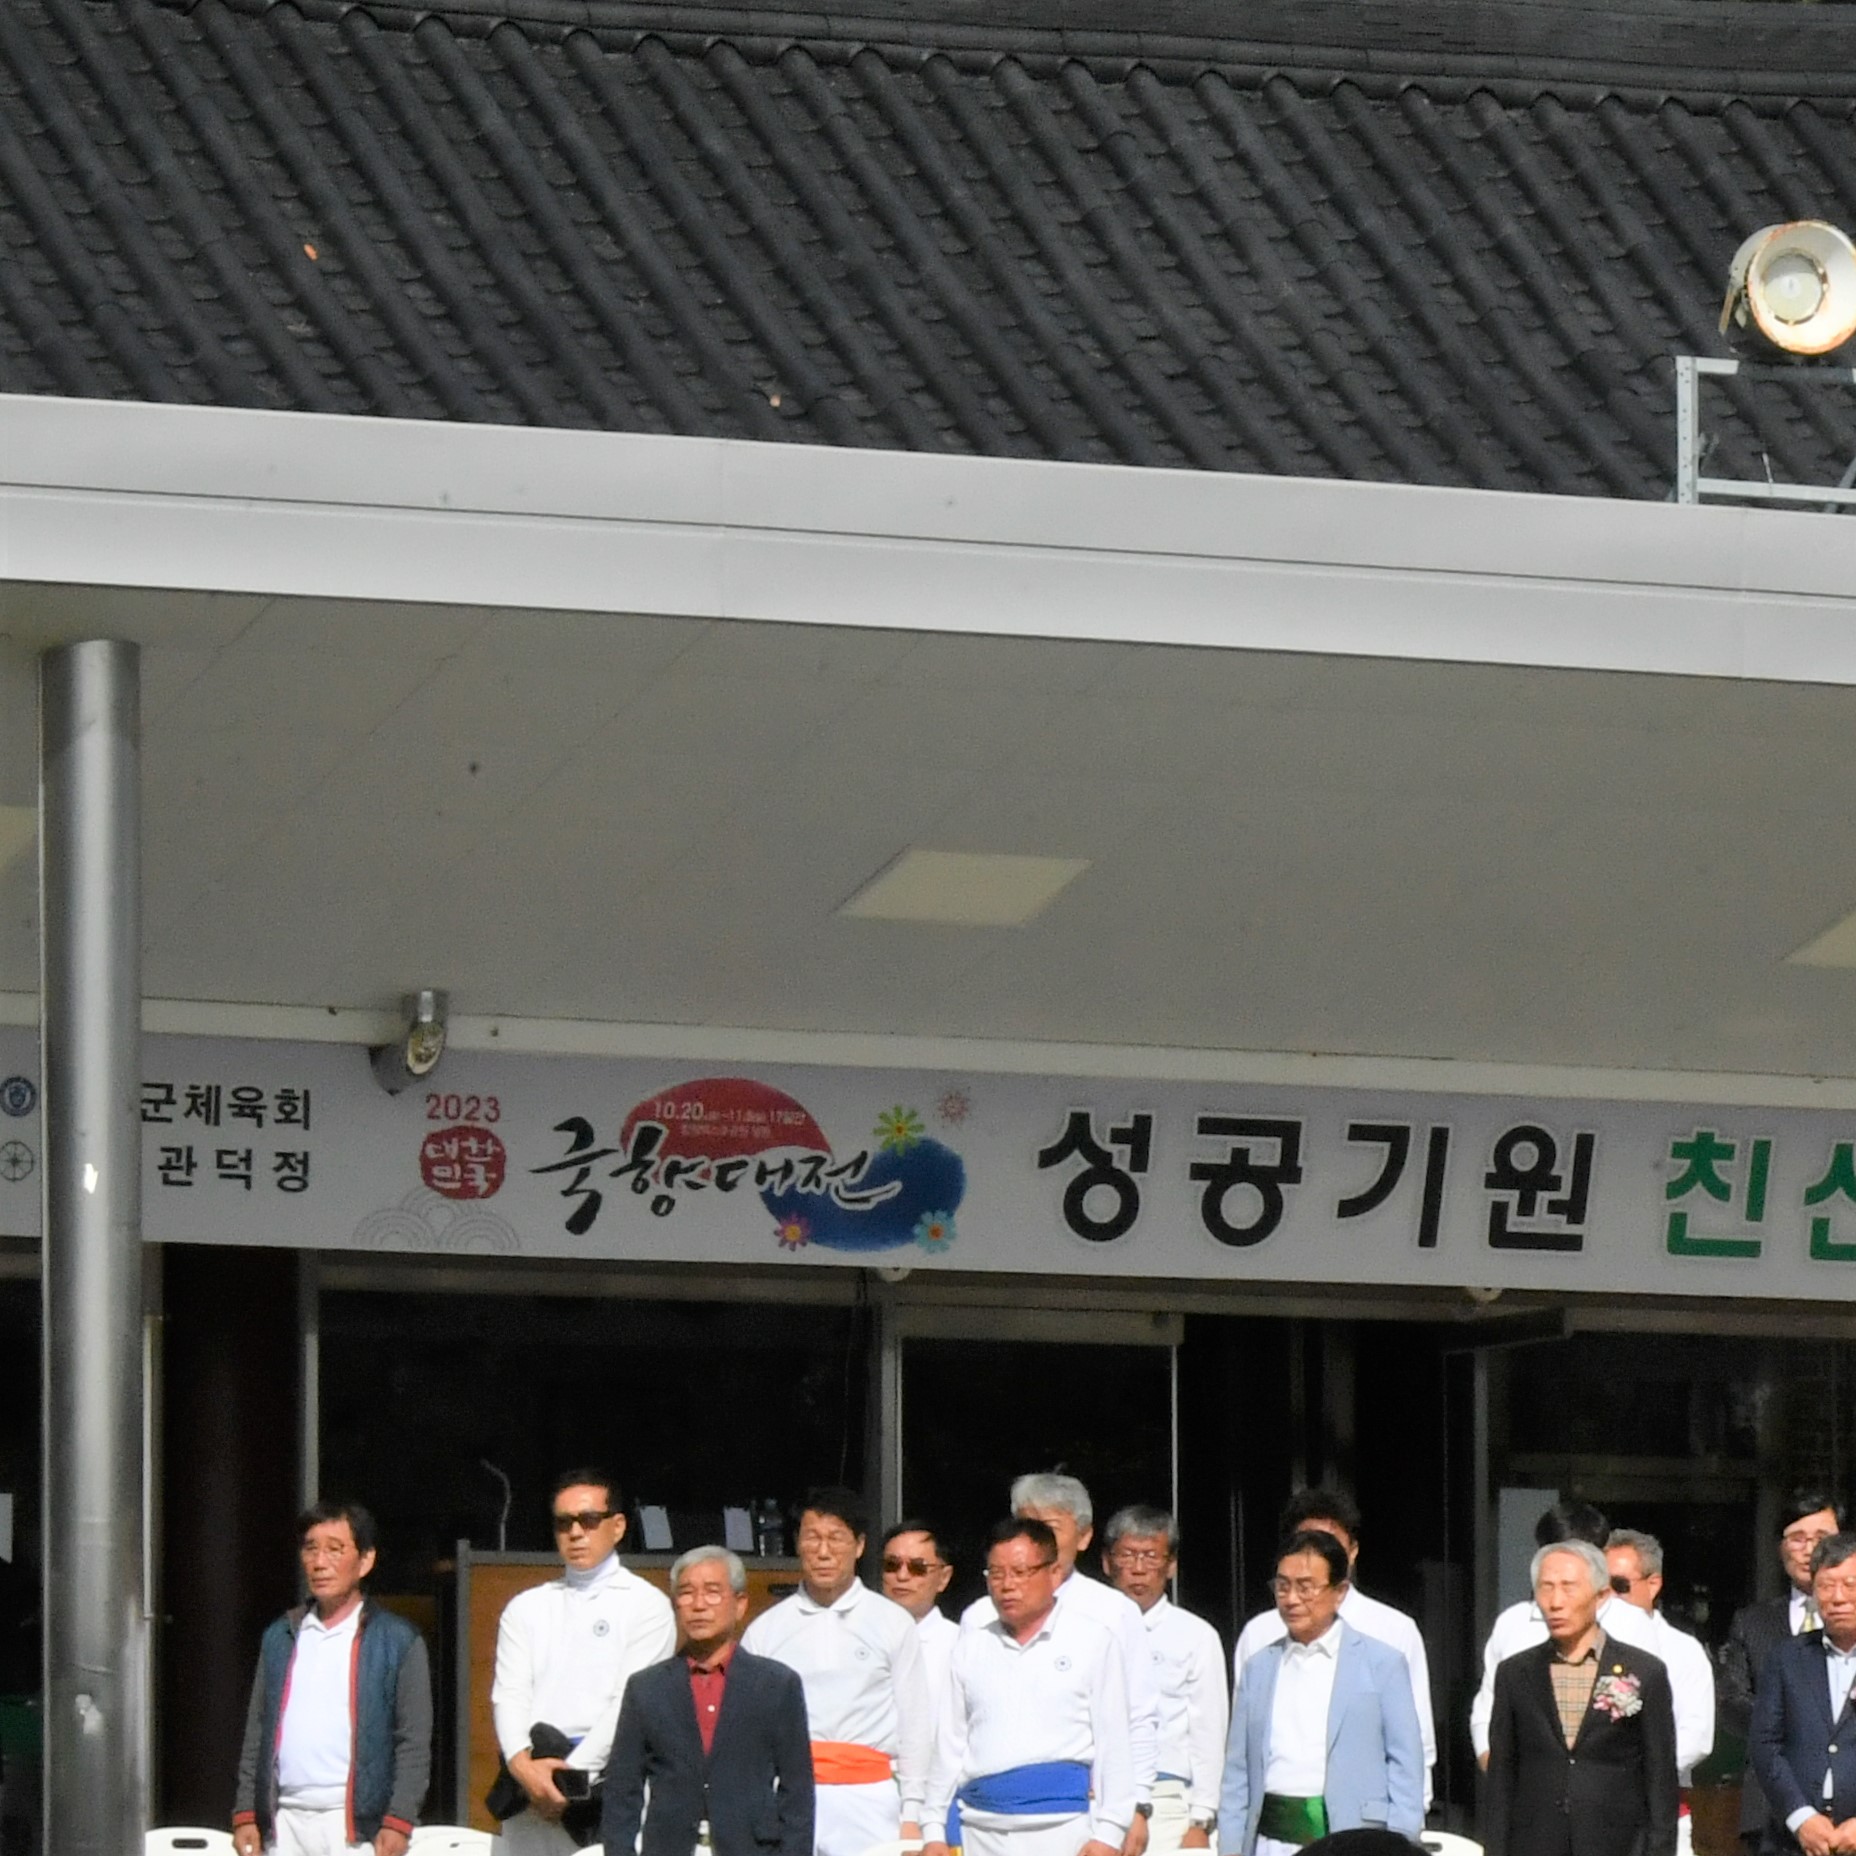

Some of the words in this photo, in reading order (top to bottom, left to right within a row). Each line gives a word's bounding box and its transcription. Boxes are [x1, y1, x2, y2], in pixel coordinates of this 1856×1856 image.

[426, 1093, 501, 1123] 2023
[157, 1145, 310, 1193] 관덕정
[529, 1116, 902, 1236] 국향대전
[1037, 1111, 1596, 1252] 성공기원
